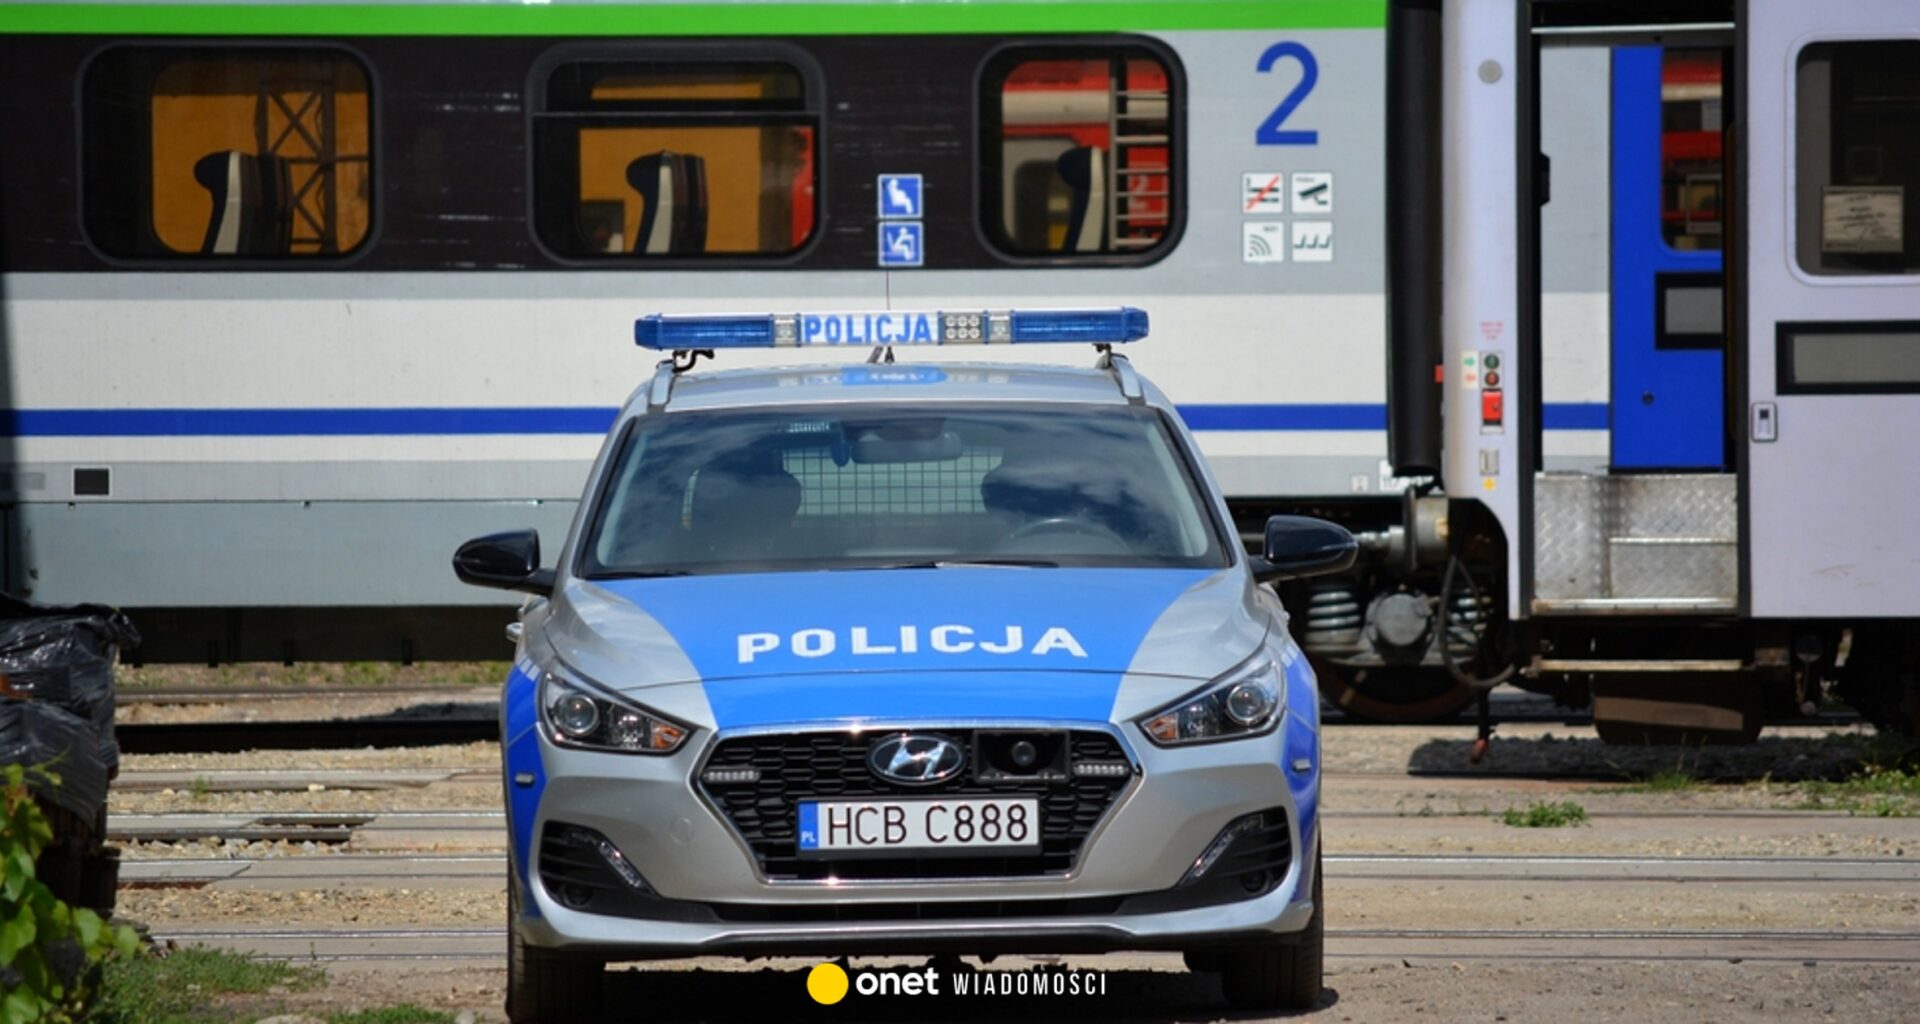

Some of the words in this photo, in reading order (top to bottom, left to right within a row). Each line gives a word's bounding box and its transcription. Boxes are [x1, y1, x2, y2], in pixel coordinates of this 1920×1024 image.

[1256, 41, 1318, 145] 2
[804, 313, 932, 345] POLICJA
[738, 625, 1089, 664] POLICJA
[801, 832, 816, 843] PL
[828, 805, 907, 845] HCB
[925, 803, 1028, 843] C888
